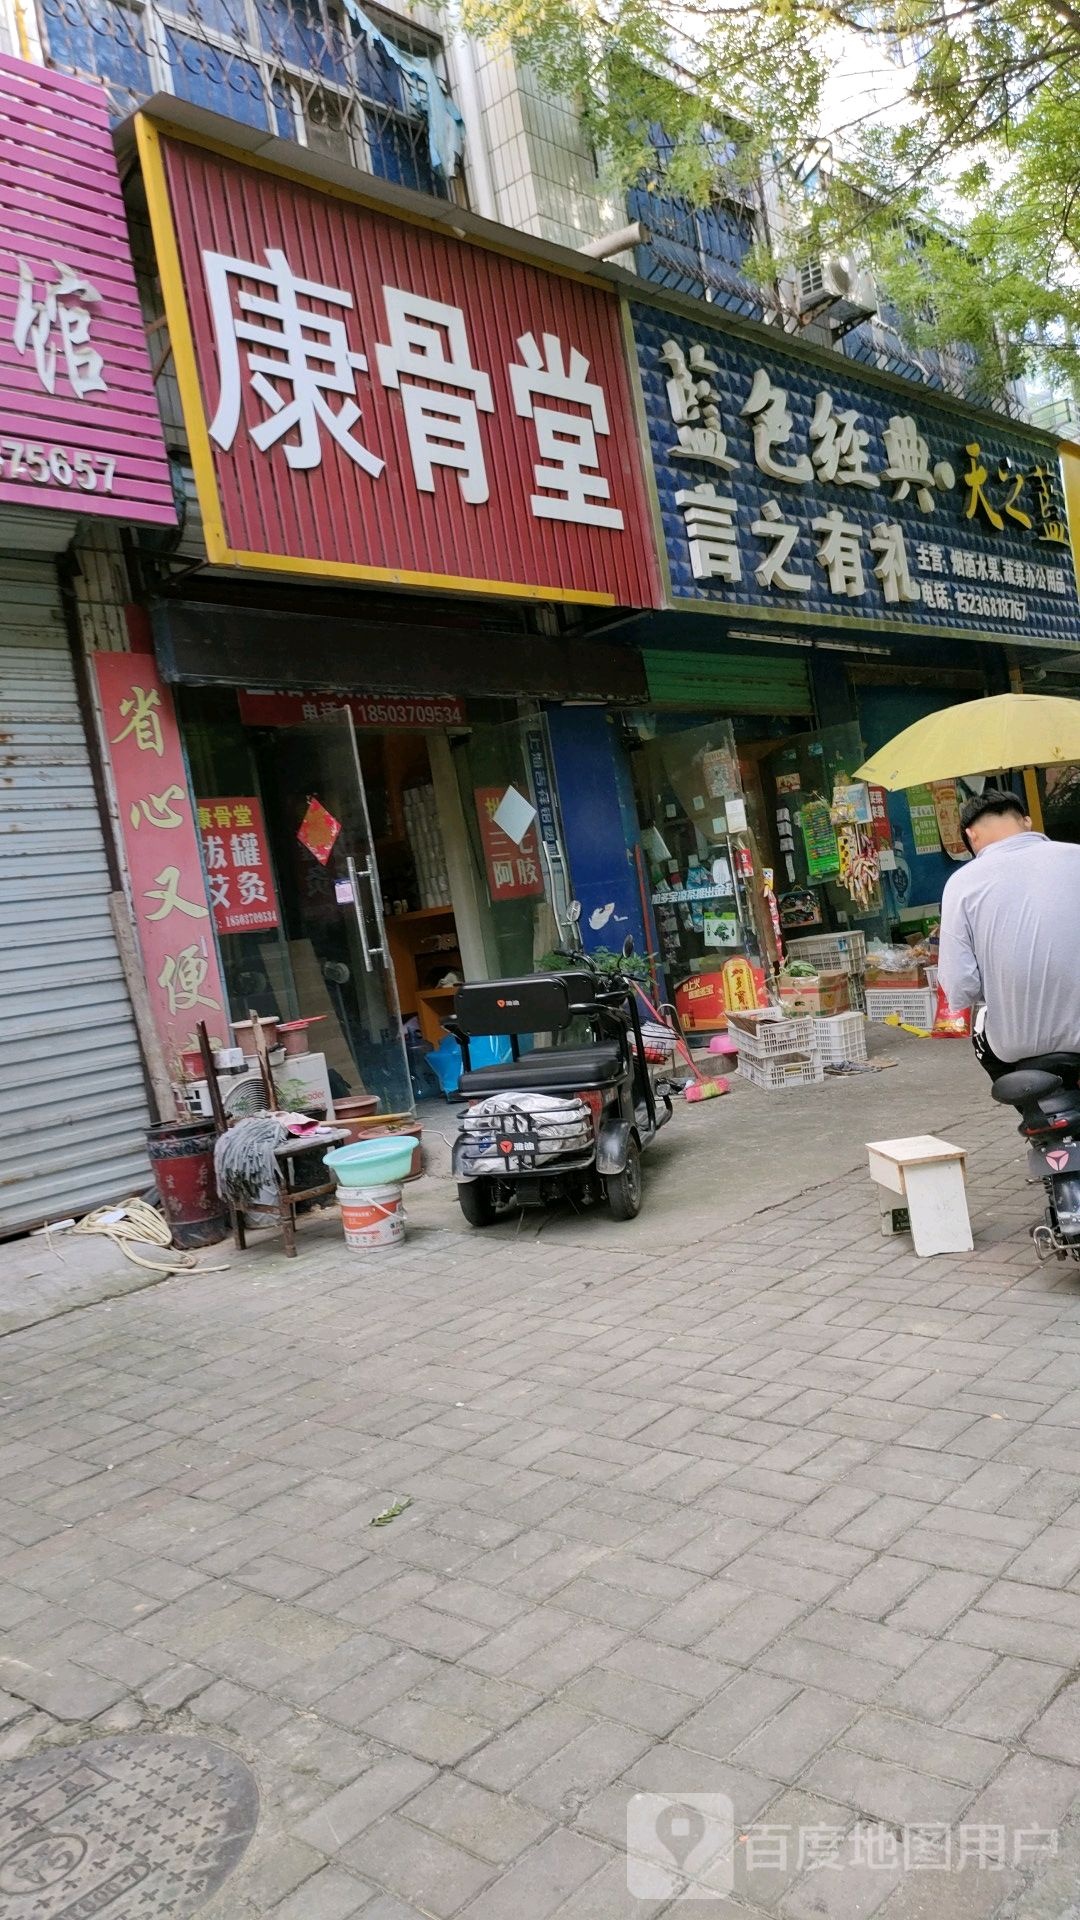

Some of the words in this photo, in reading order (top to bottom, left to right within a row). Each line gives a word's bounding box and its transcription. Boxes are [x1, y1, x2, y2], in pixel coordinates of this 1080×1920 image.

[13, 257, 108, 400] 馆
[202, 248, 625, 530] 康骨堂
[0, 440, 117, 493] 75657
[675, 483, 921, 603] 言之有礼
[358, 703, 463, 723] 18503709534
[207, 871, 268, 909] 艾灸
[493, 860, 539, 888] 阿胶
